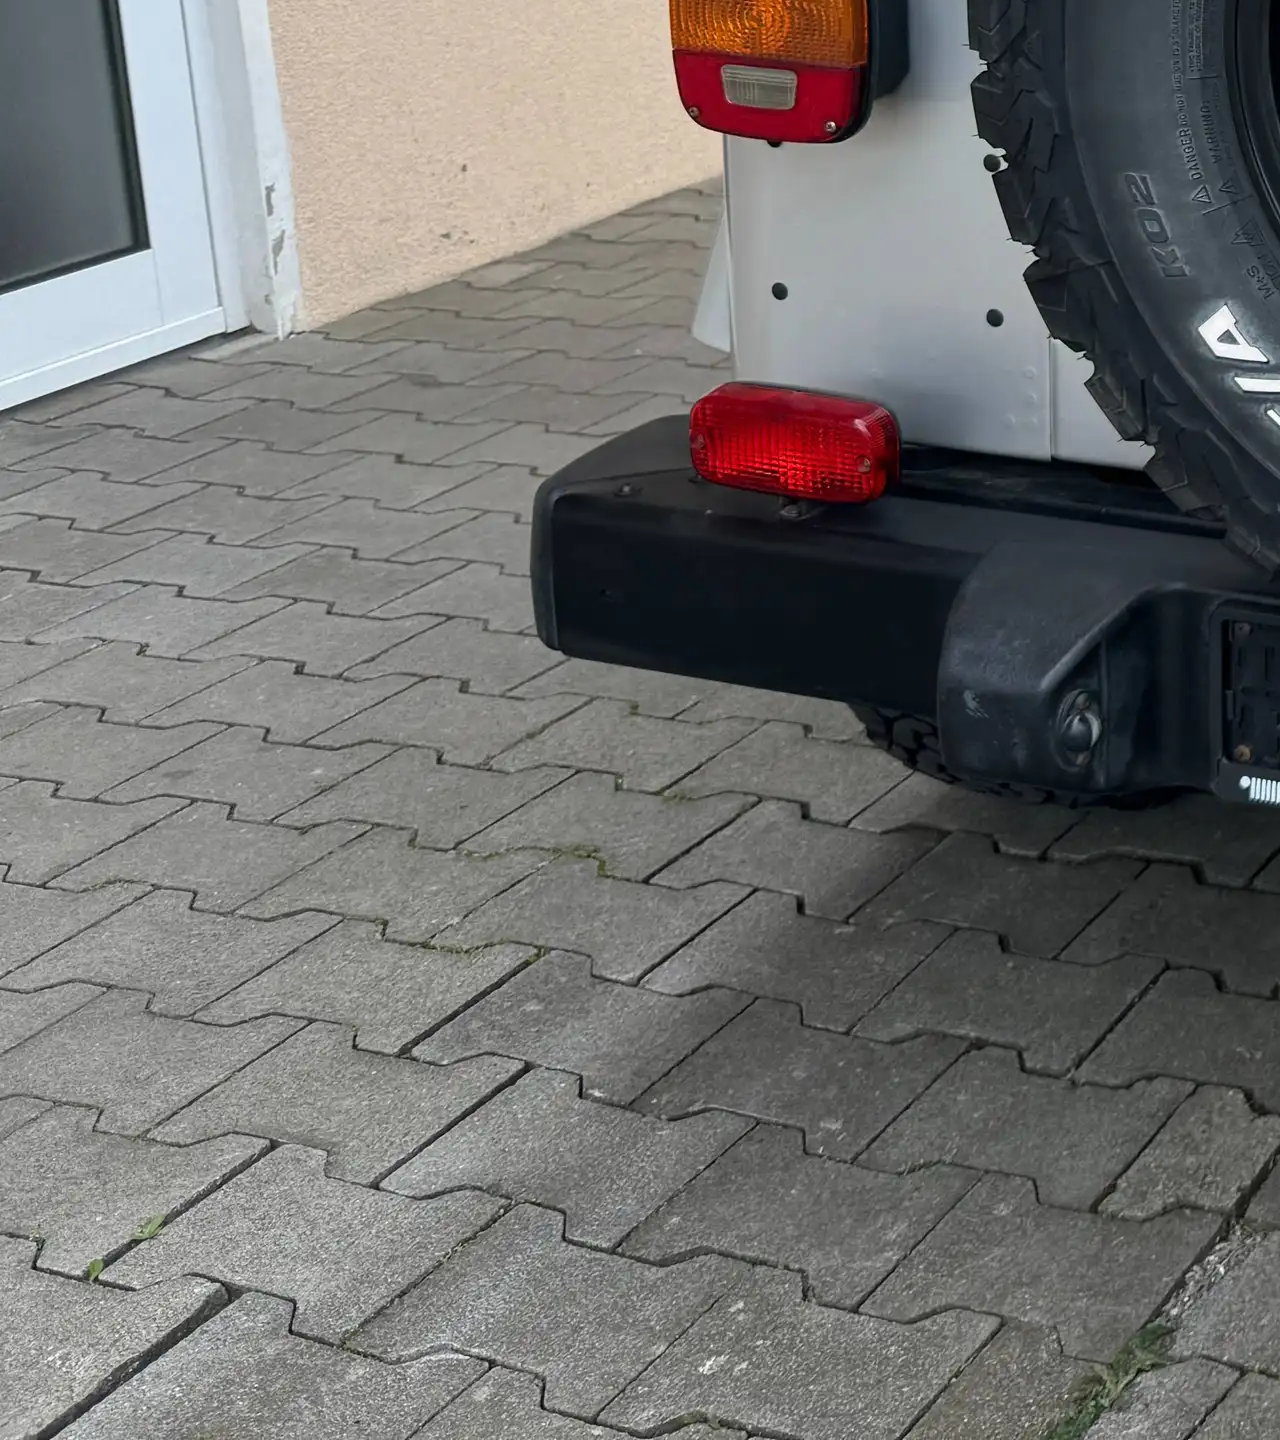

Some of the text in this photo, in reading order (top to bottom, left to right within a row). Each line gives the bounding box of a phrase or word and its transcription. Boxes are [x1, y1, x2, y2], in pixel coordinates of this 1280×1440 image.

[1178, 127, 1204, 181] DANGER
[1123, 171, 1189, 279] KO2
[1245, 264, 1276, 301] M+S
